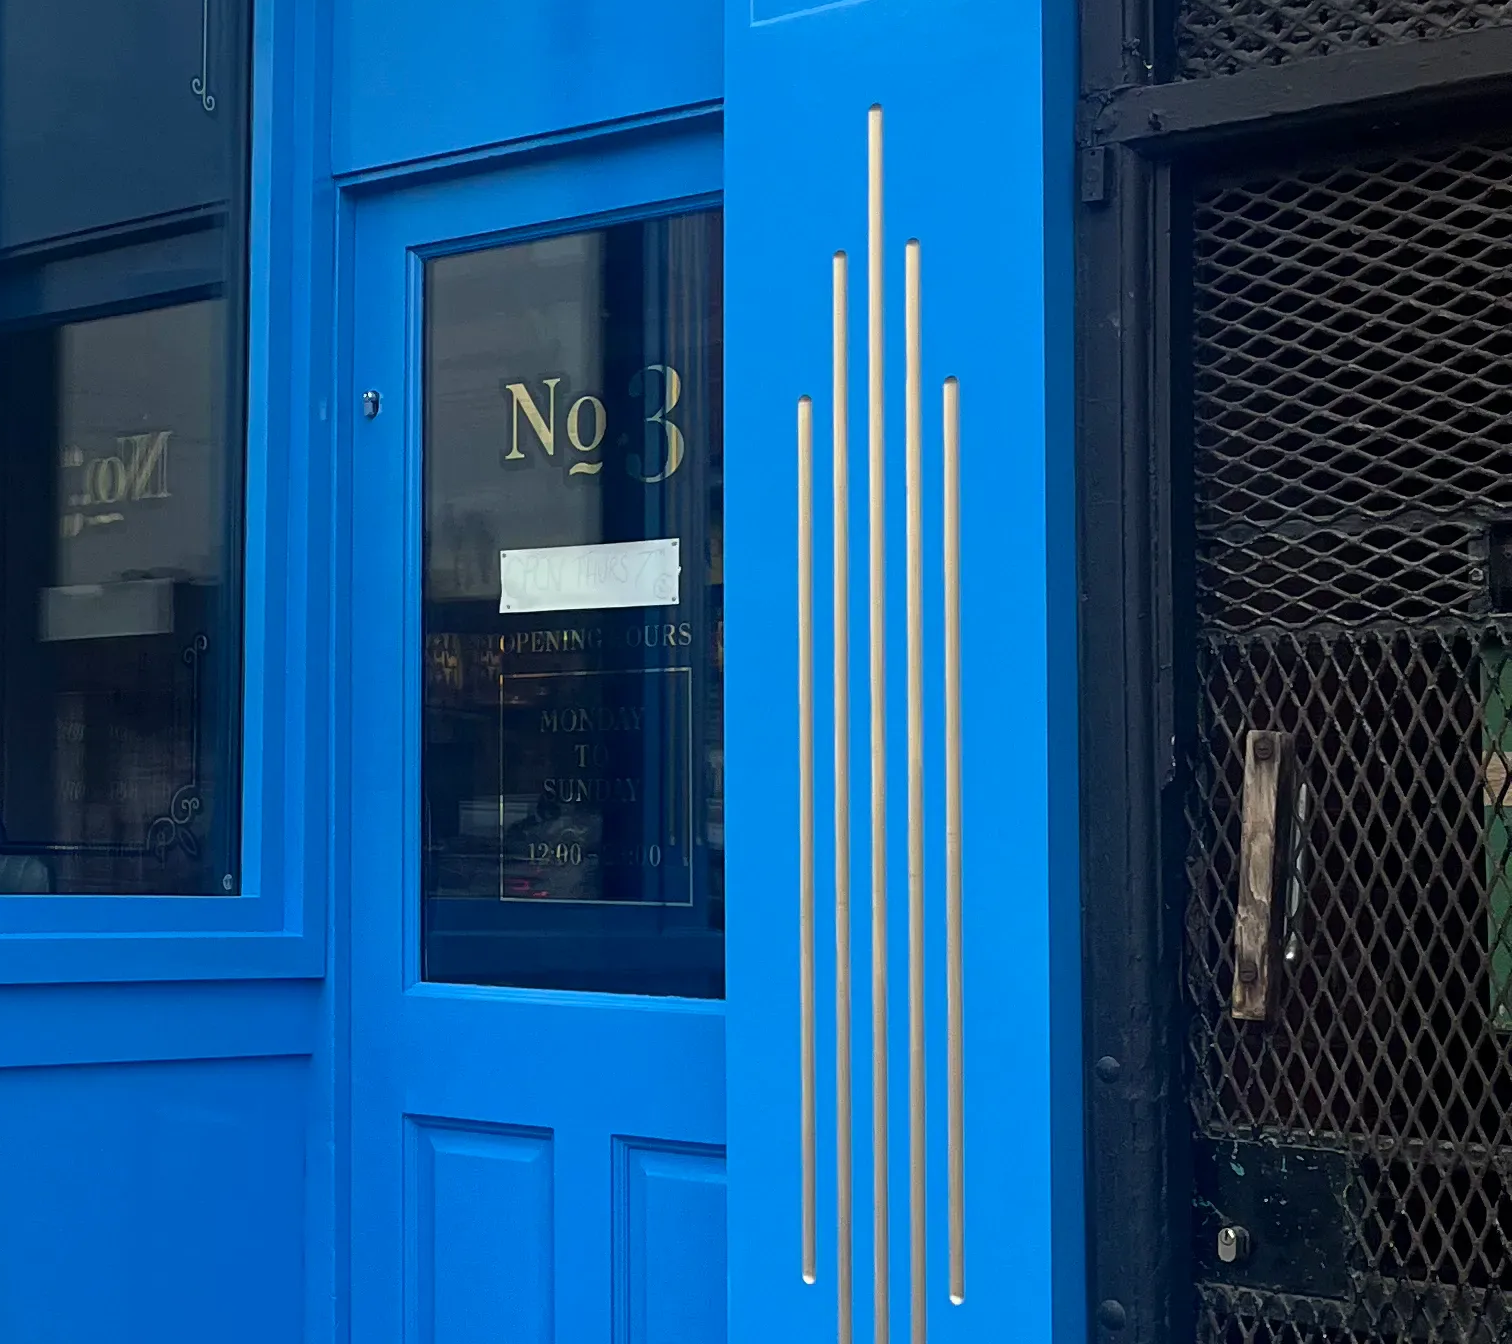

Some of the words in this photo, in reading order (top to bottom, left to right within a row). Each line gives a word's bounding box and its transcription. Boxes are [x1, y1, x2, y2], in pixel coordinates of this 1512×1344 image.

[500, 627, 603, 654] OPENING
[540, 706, 646, 733] MONDAY
[574, 744, 609, 769] TO
[543, 778, 641, 803] SUNDAY
